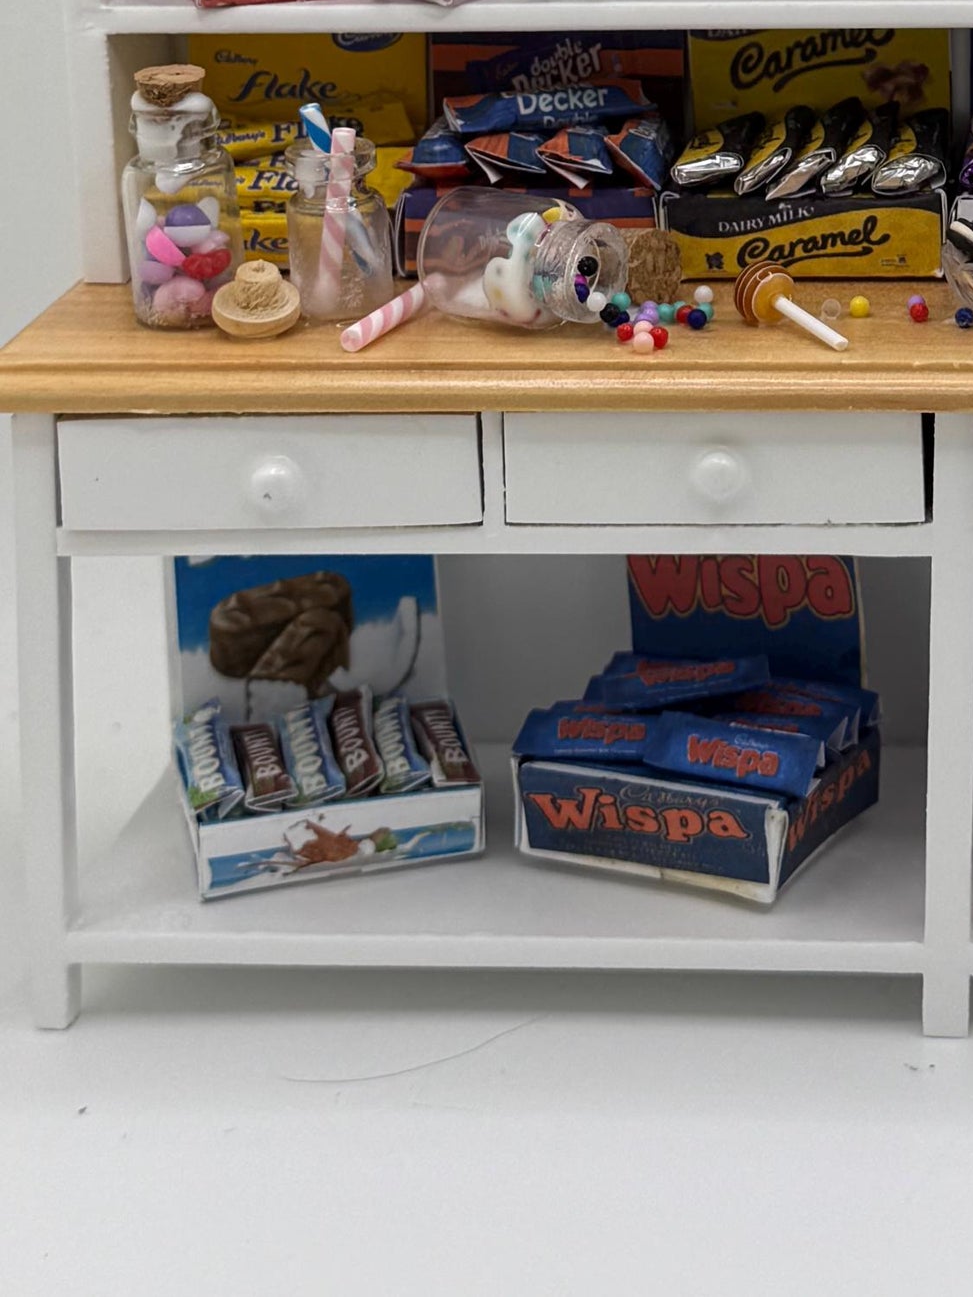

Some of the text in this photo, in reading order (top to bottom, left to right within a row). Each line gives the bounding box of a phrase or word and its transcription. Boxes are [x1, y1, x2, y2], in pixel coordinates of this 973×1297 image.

[229, 68, 337, 103] Flake
[516, 88, 609, 116] Decker
[717, 203, 812, 233] DAIRY MILK
[736, 214, 892, 269] Caramel
[627, 555, 855, 630] Wispa
[635, 658, 736, 687] Wispa
[557, 716, 646, 744] Wispa
[686, 734, 780, 778] Wispa
[527, 786, 751, 844] Wispa
